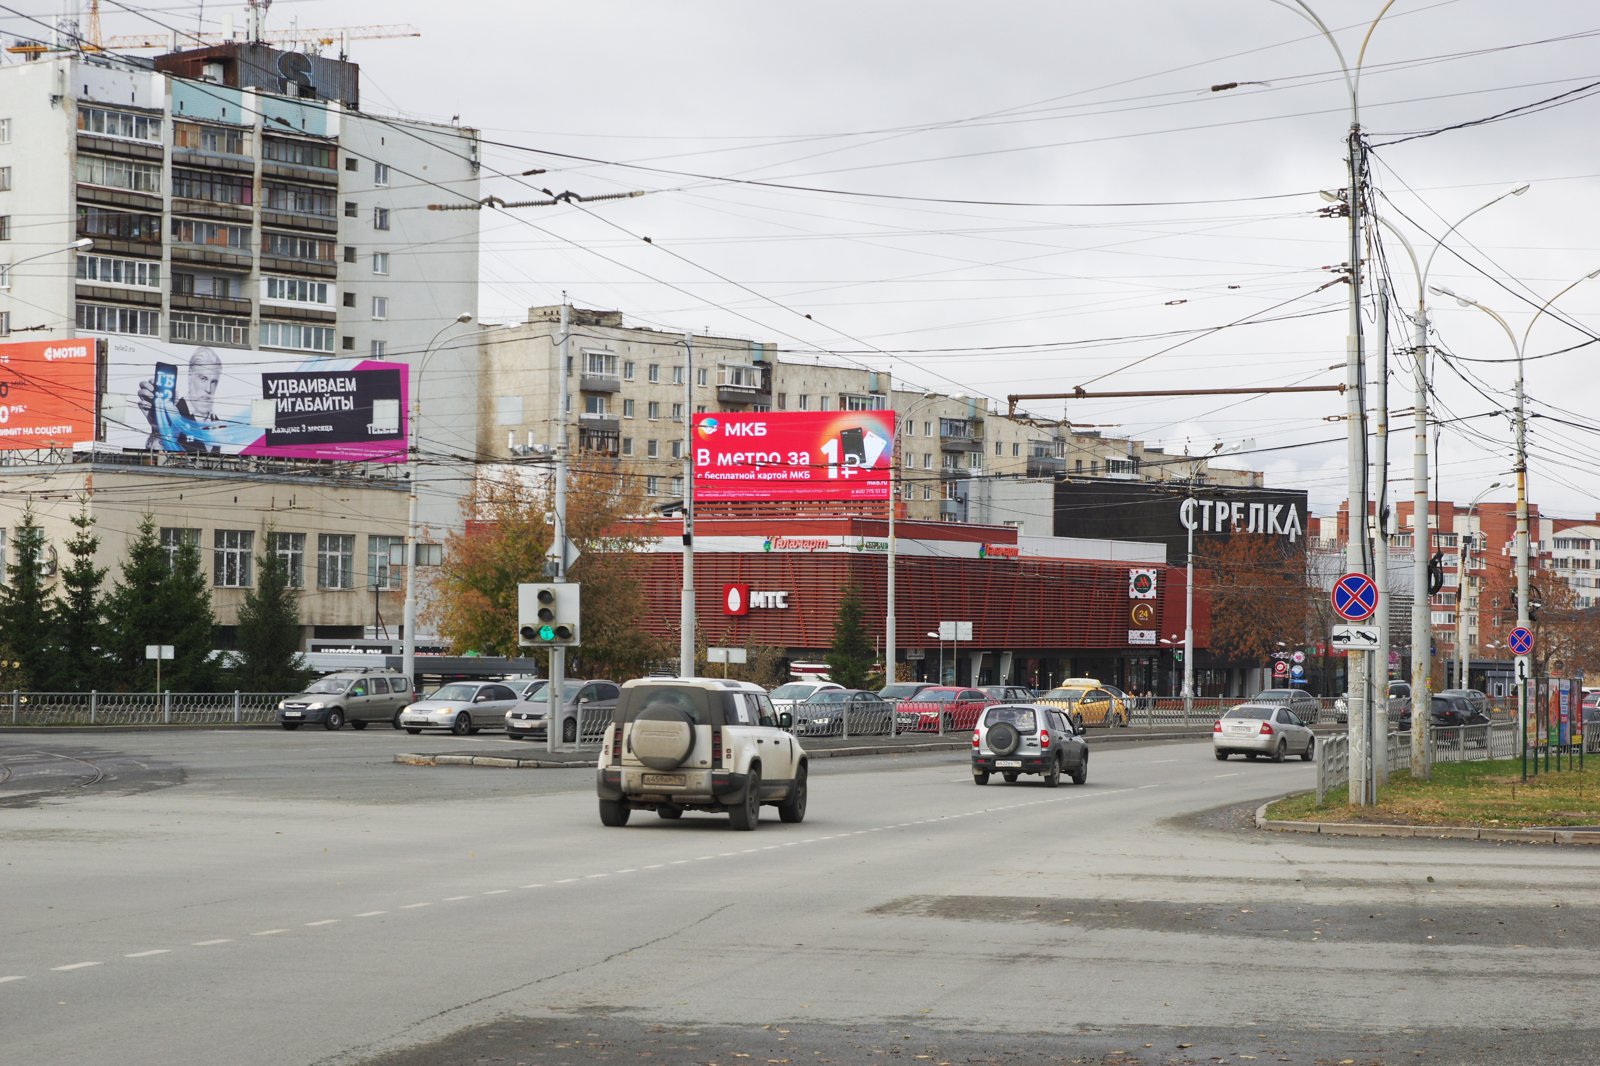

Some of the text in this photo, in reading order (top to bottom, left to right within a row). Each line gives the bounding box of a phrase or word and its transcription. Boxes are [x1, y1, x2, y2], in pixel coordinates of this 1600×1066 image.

[53, 346, 87, 359] МОТИВ
[156, 371, 175, 388] ГБ
[268, 377, 357, 397] УДВАИВАЕМ
[273, 393, 355, 412] ИГАБАЙТЫ
[35, 426, 72, 436] СОЦСЕТИ
[301, 424, 306, 433] 3
[307, 425, 333, 433] месяца
[725, 422, 767, 437] МКБ
[697, 448, 810, 471] В метро за
[705, 471, 755, 480] бесплатной
[757, 471, 787, 480] картой
[789, 470, 810, 479] МКБ
[1179, 497, 1303, 543] СТРЕЛКА
[750, 591, 788, 609] МТС
[1138, 610, 1149, 618] 24
